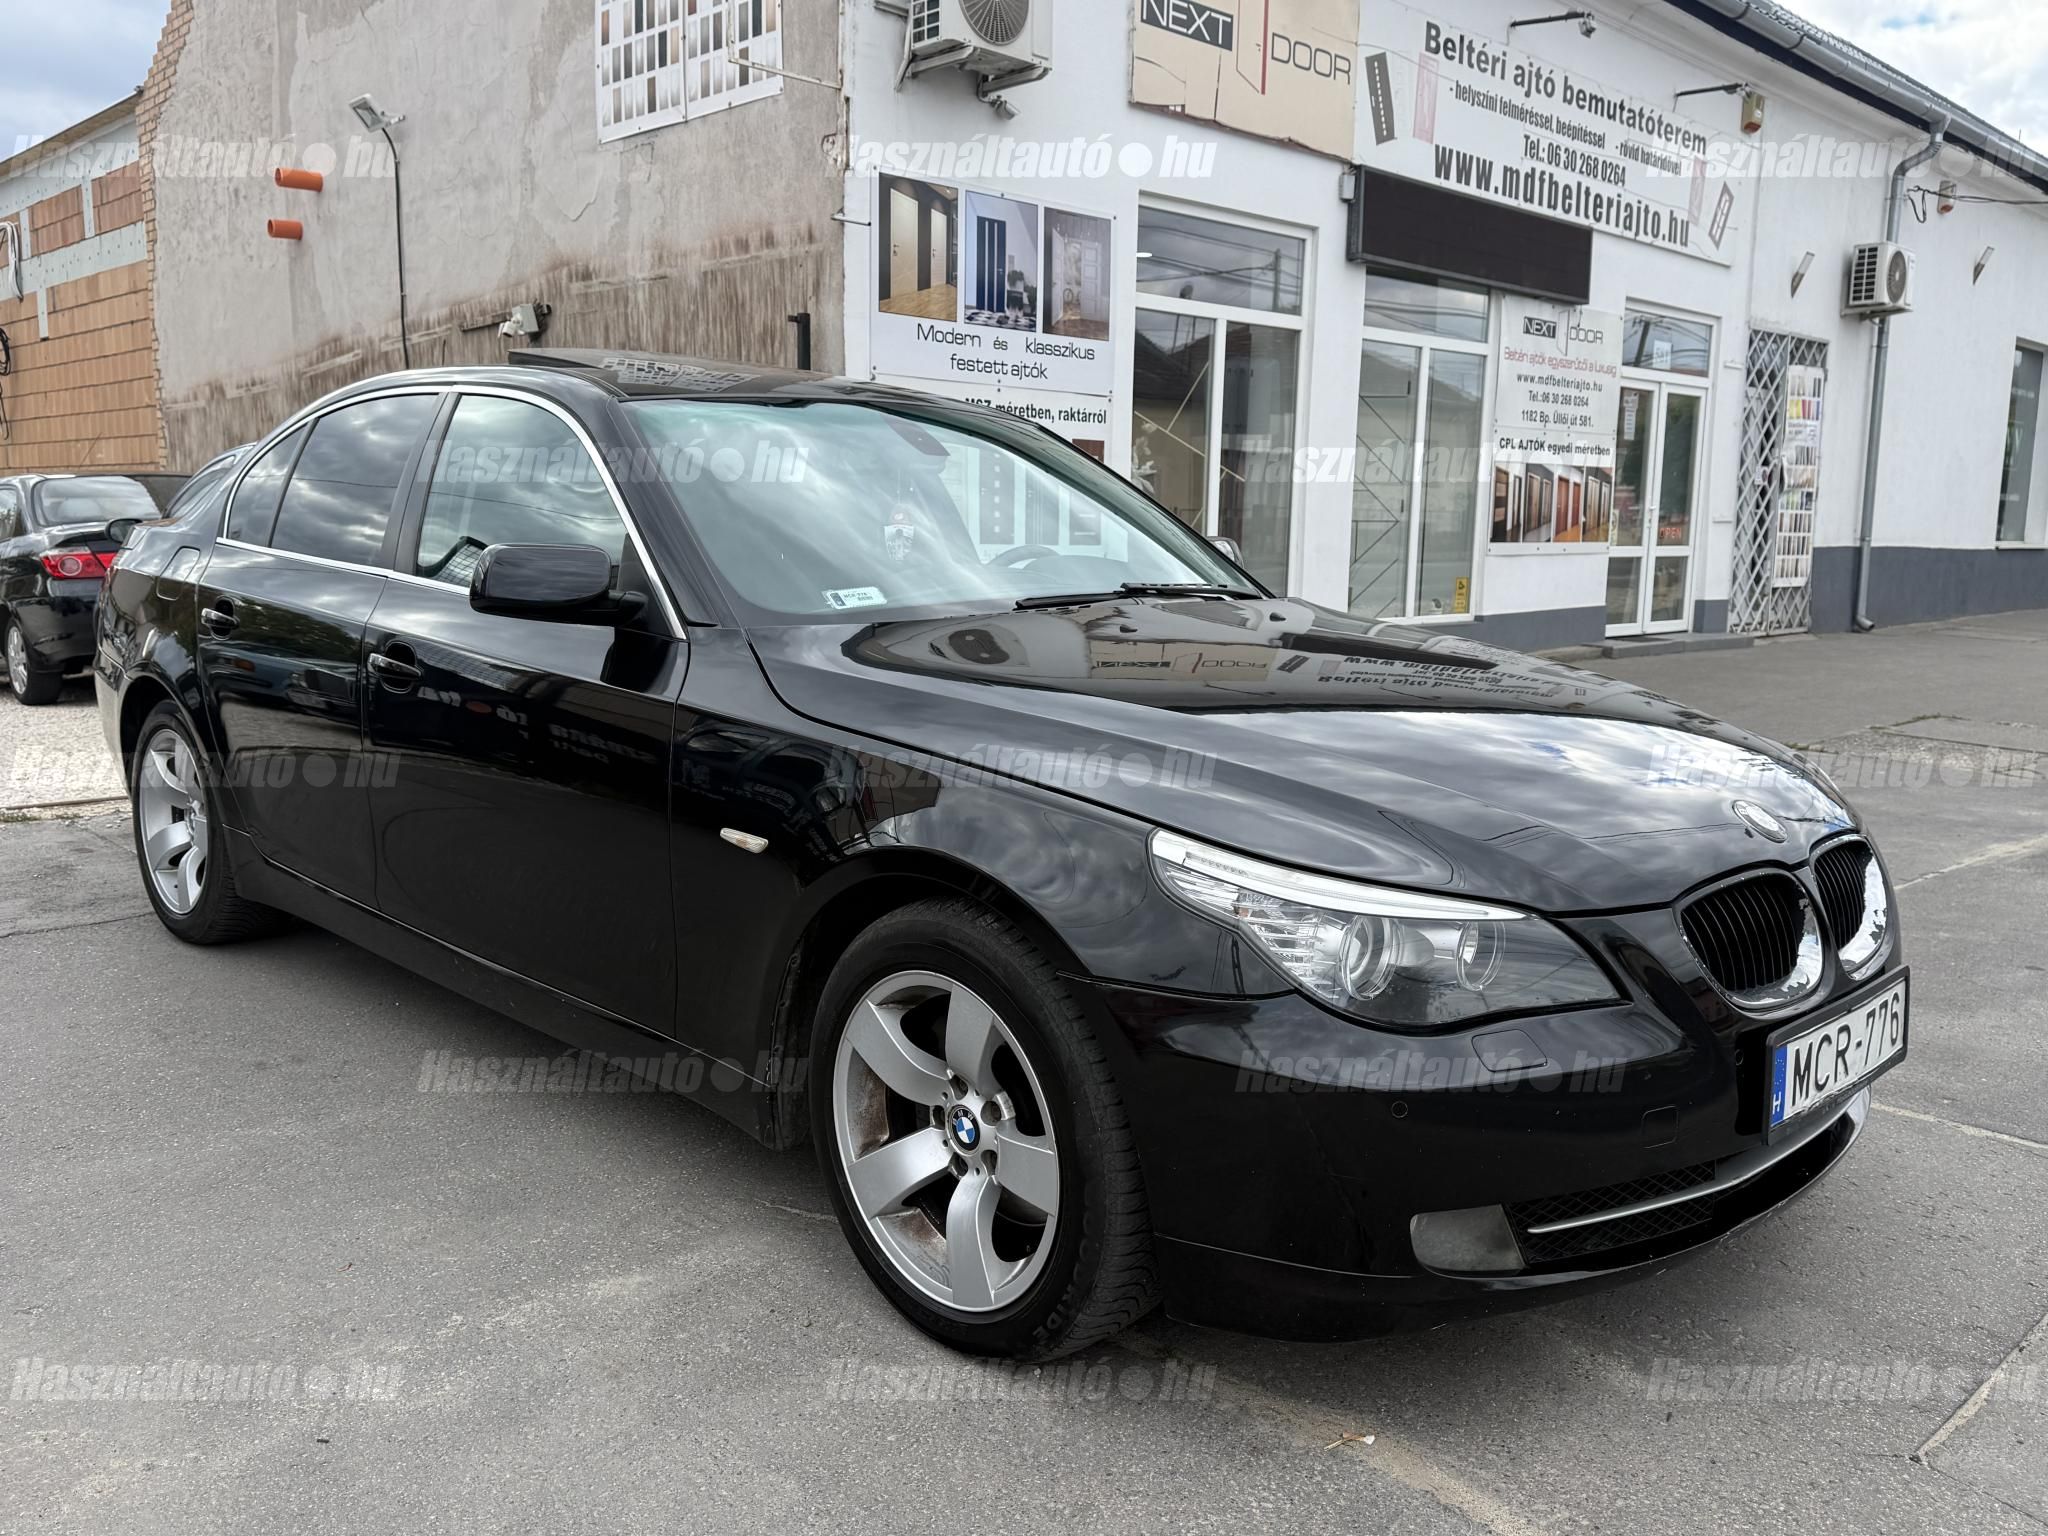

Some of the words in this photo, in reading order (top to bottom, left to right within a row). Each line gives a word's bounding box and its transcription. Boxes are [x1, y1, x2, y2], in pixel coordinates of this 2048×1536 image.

[1142, 0, 1232, 45] NEXT
[1271, 32, 1351, 85] DOOR
[1425, 20, 1507, 81] Beltéri
[1513, 60, 1556, 99] ajtó
[1562, 75, 1706, 155] bemutatóterem
[1455, 80, 1498, 111] helyszíni
[1556, 116, 1605, 149] beépítéssel
[1523, 134, 1545, 162] Tel.:
[1547, 142, 1561, 165] 06
[1563, 146, 1577, 170] 30
[1579, 151, 1599, 178] 268
[1601, 157, 1626, 186] 0264
[1434, 143, 1690, 248] www.mdfbelteriajto.hu
[917, 323, 981, 347] Modern
[993, 336, 1008, 351] és
[1025, 337, 1095, 360] klasszikus
[1523, 317, 1556, 337] NEXT
[1569, 326, 1604, 344] DOOR
[949, 353, 1008, 375] festett
[1010, 361, 1048, 381] ajtók
[1516, 373, 1603, 392] www.mdfbelteriajto.hu
[1058, 407, 1107, 424] raktárról
[1499, 437, 1516, 449] CPL
[1518, 437, 1546, 452] AJTÓK
[1547, 442, 1573, 455] egyedi
[1574, 443, 1611, 456] méretben
[1792, 992, 1900, 1107] MCR-776
[1772, 1091, 1782, 1116] H
